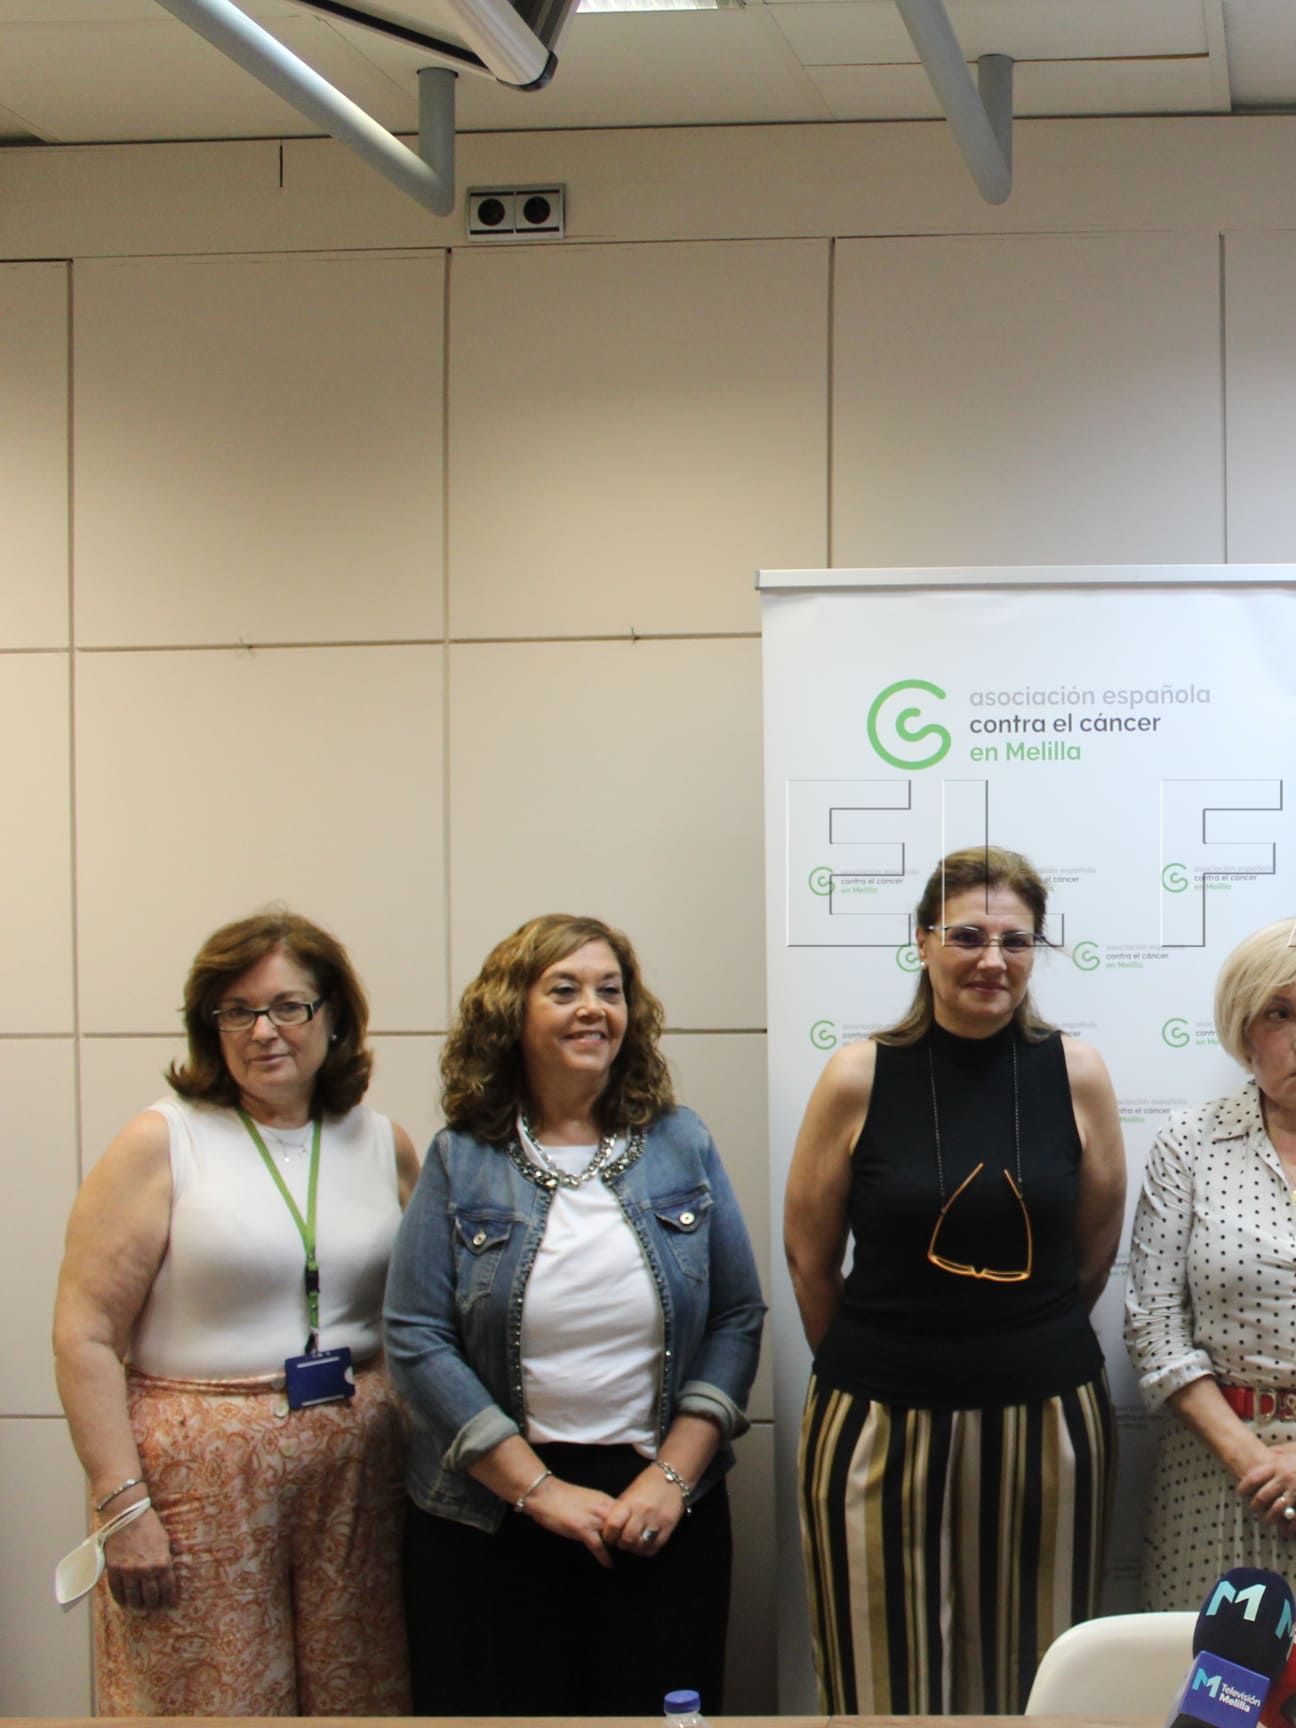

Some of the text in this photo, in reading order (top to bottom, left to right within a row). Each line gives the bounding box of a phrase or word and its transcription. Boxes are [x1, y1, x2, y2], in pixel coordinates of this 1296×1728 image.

[968, 683, 1211, 710] asociación española
[969, 711, 1162, 734] contra el cáncer
[969, 740, 1082, 762] en Melilla
[1218, 1693, 1251, 1714] Melilla
